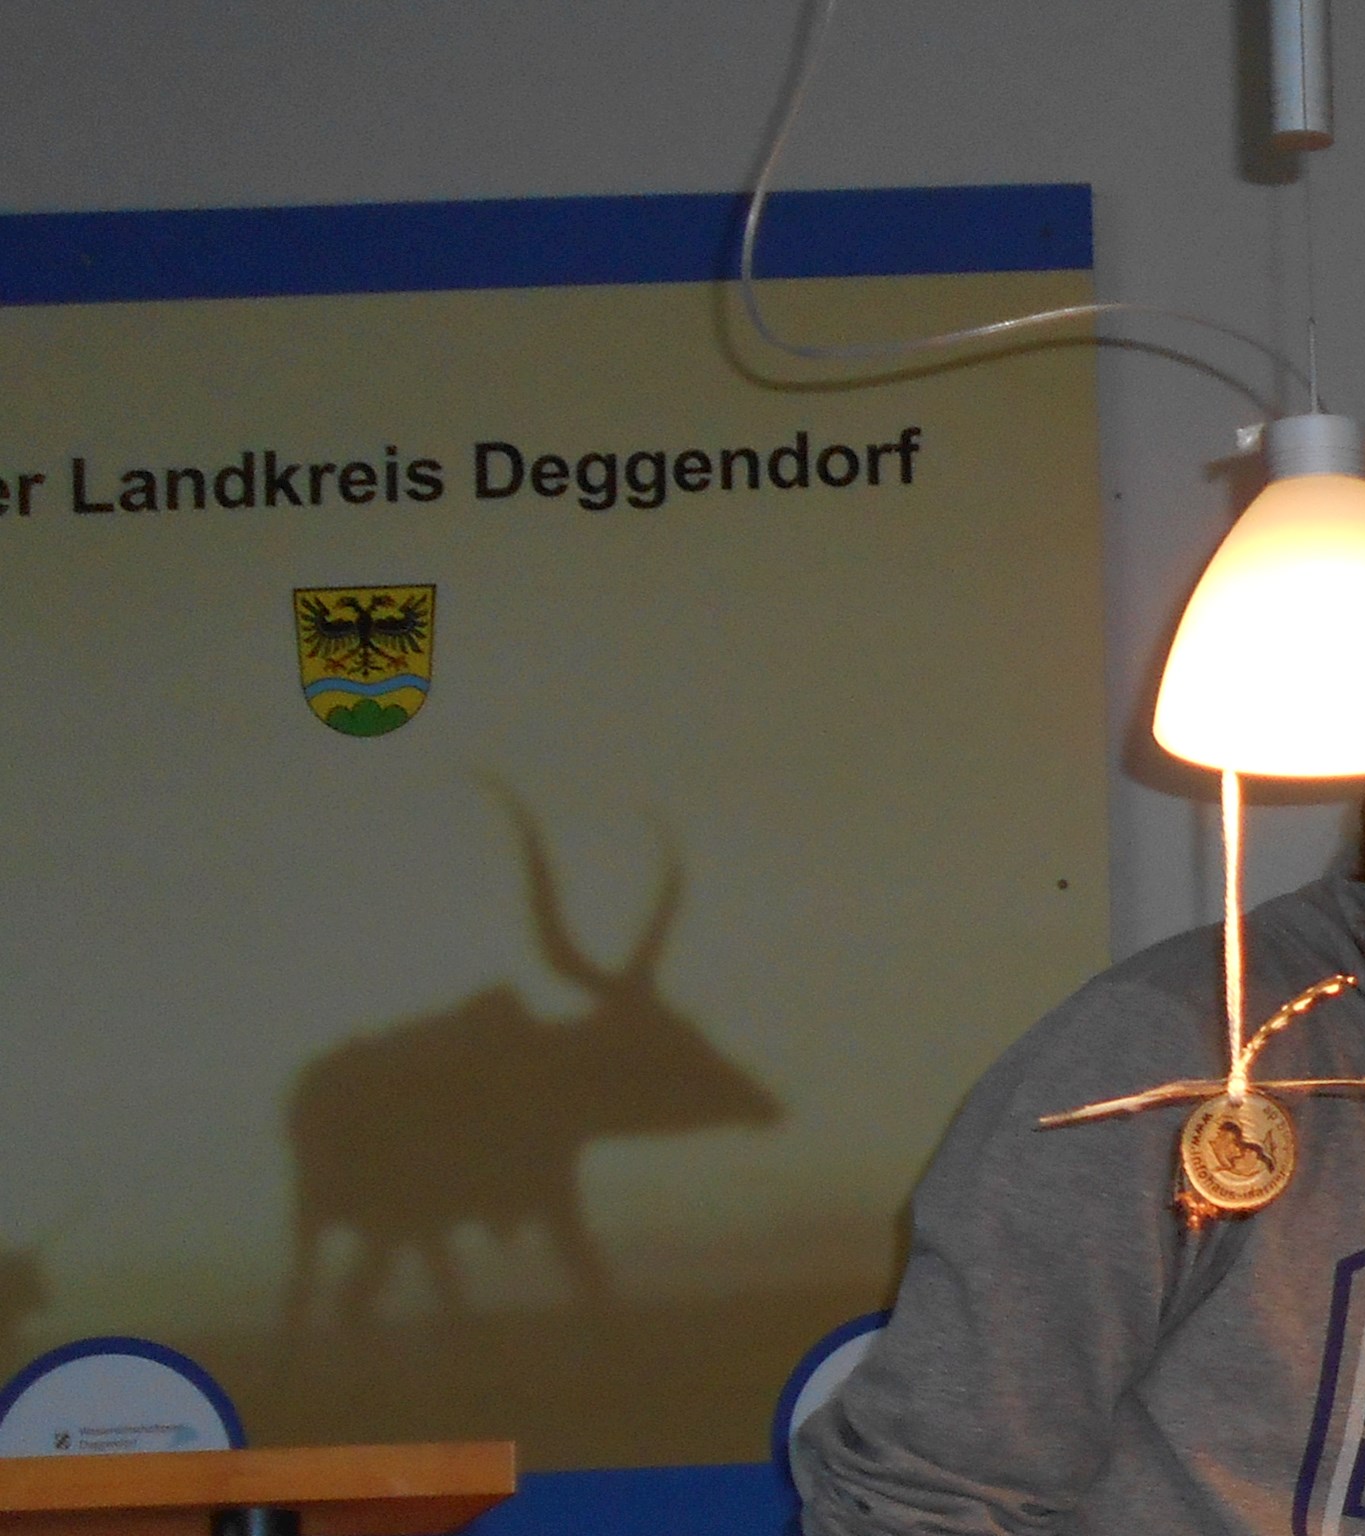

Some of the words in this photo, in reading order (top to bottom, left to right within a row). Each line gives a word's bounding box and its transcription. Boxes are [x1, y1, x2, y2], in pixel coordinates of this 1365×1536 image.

[0, 471, 46, 516] r
[72, 444, 446, 515] Landkreis
[473, 426, 921, 512] Deggendorf
